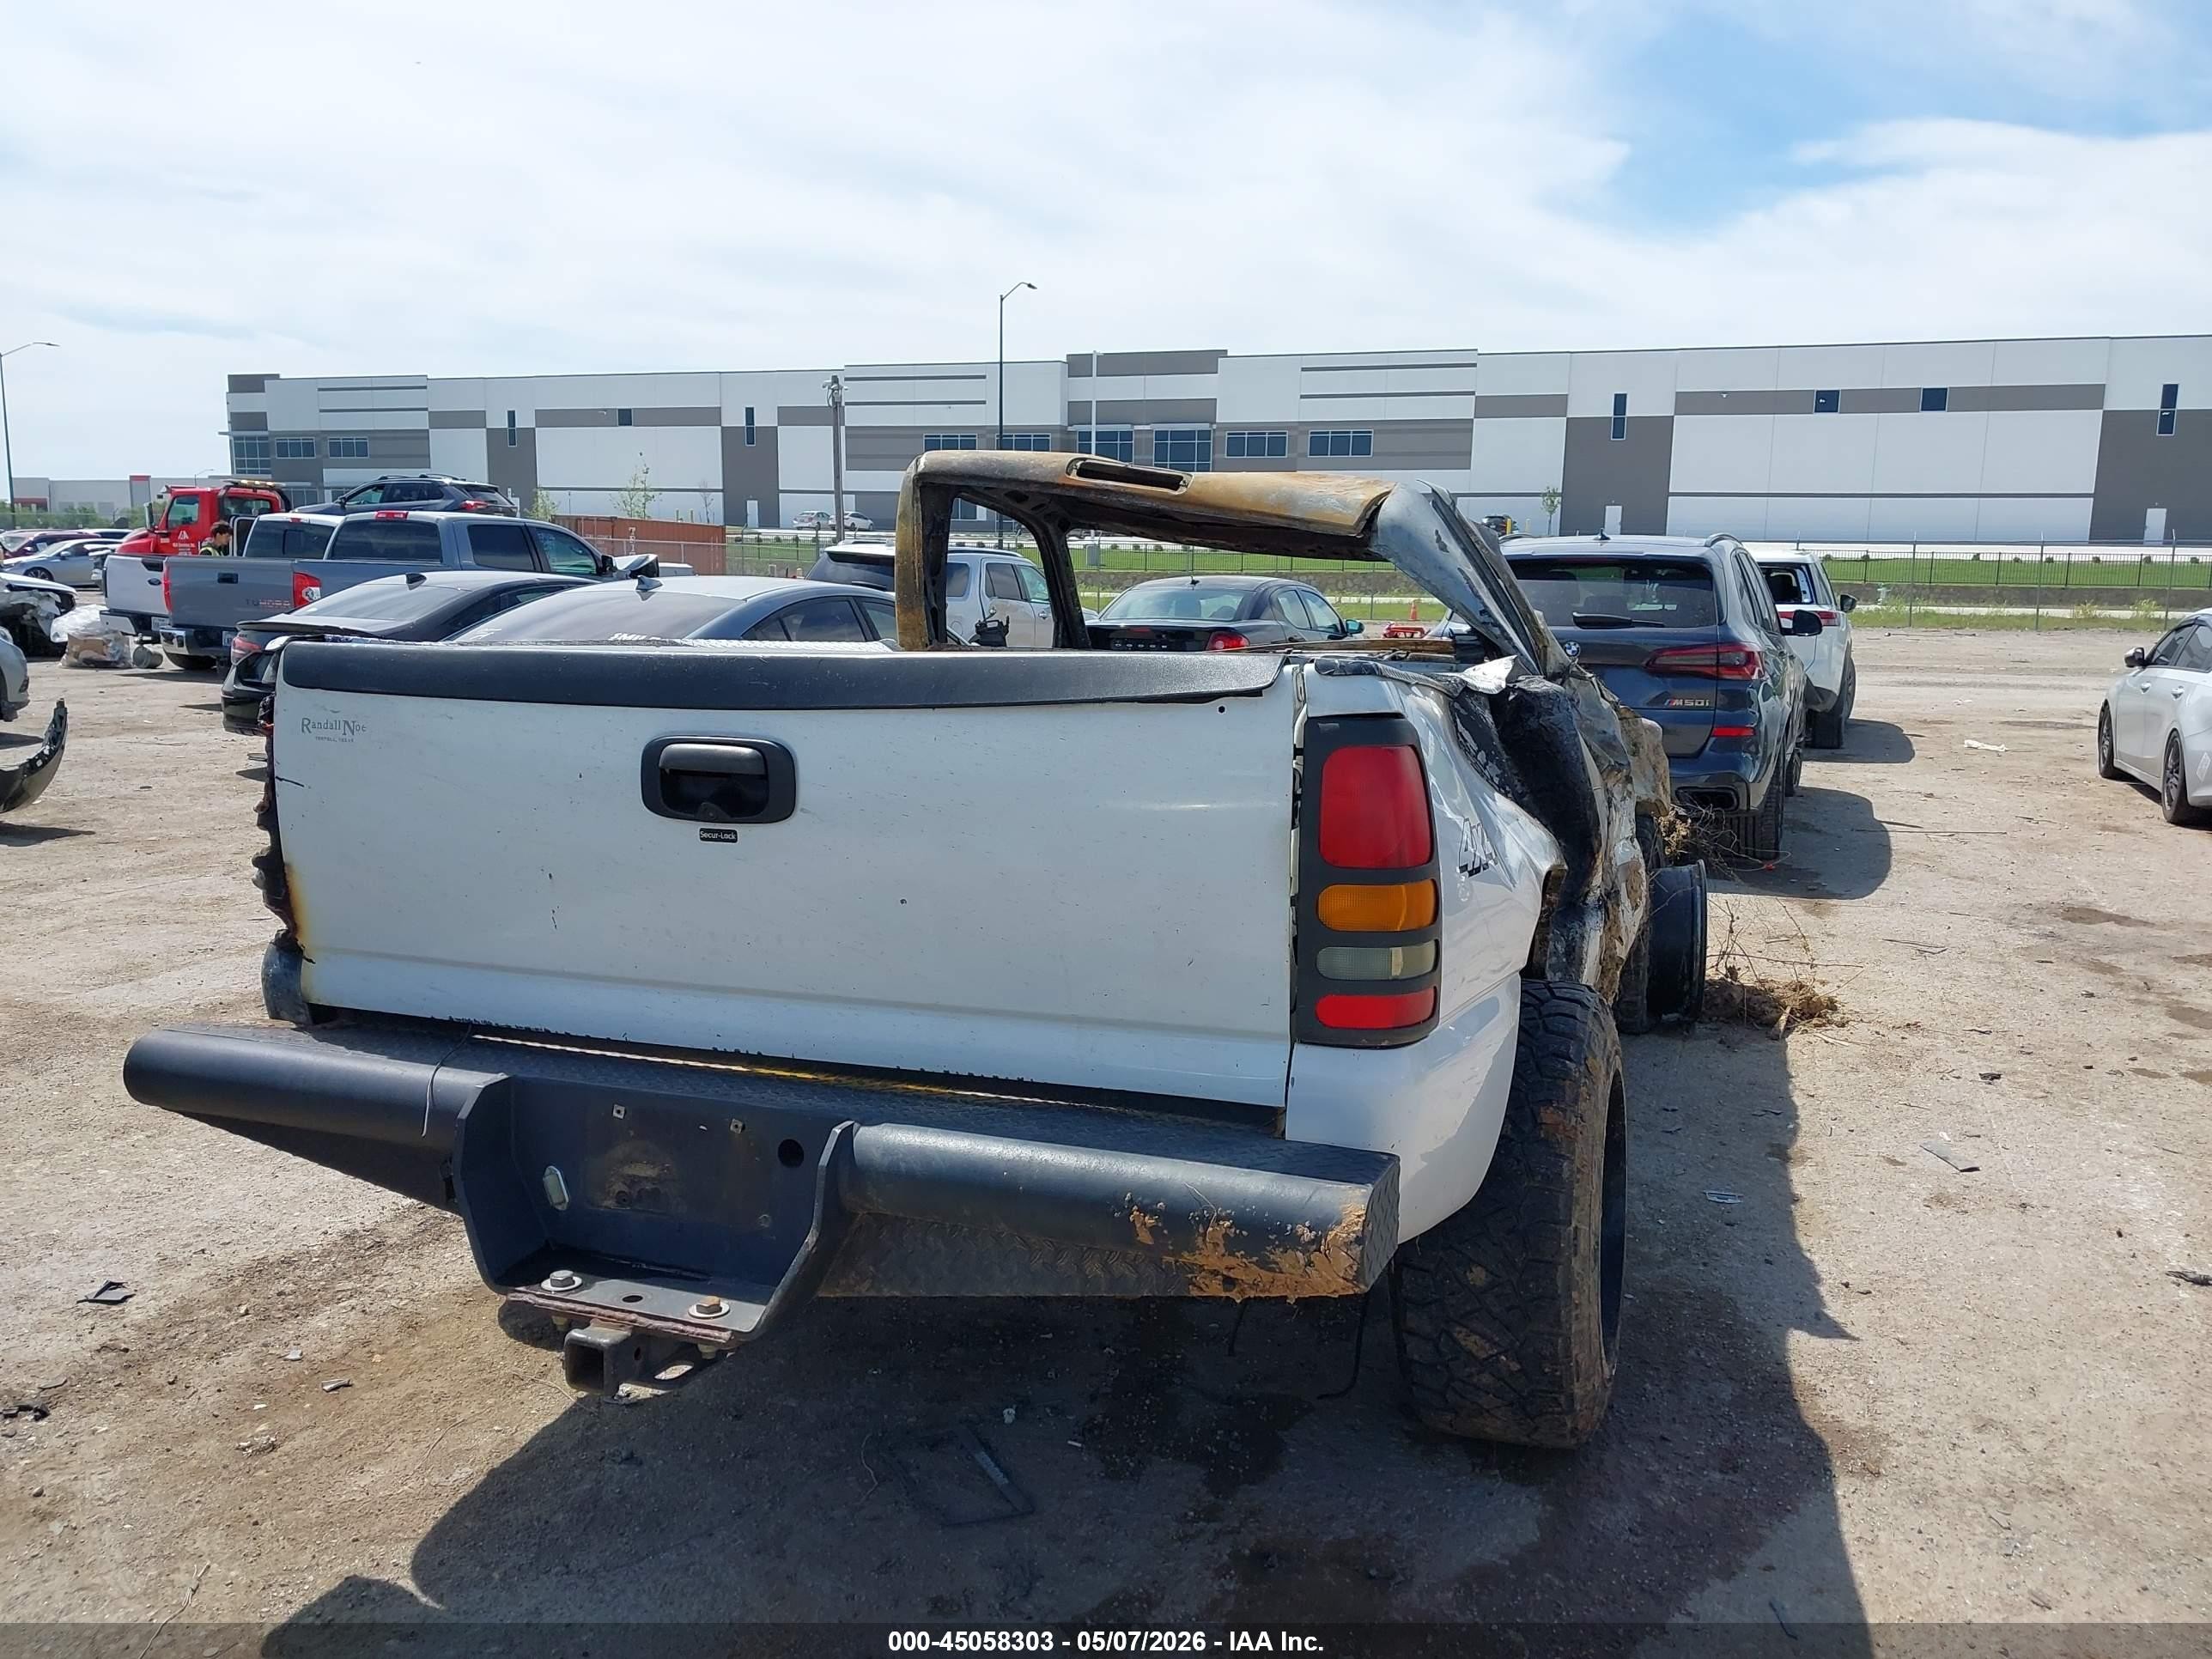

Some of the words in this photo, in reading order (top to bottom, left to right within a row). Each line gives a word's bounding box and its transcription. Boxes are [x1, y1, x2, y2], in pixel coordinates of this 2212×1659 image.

[301, 718, 341, 733] Randall
[342, 720, 368, 736] Noe
[700, 830, 737, 840] Secur-Lock
